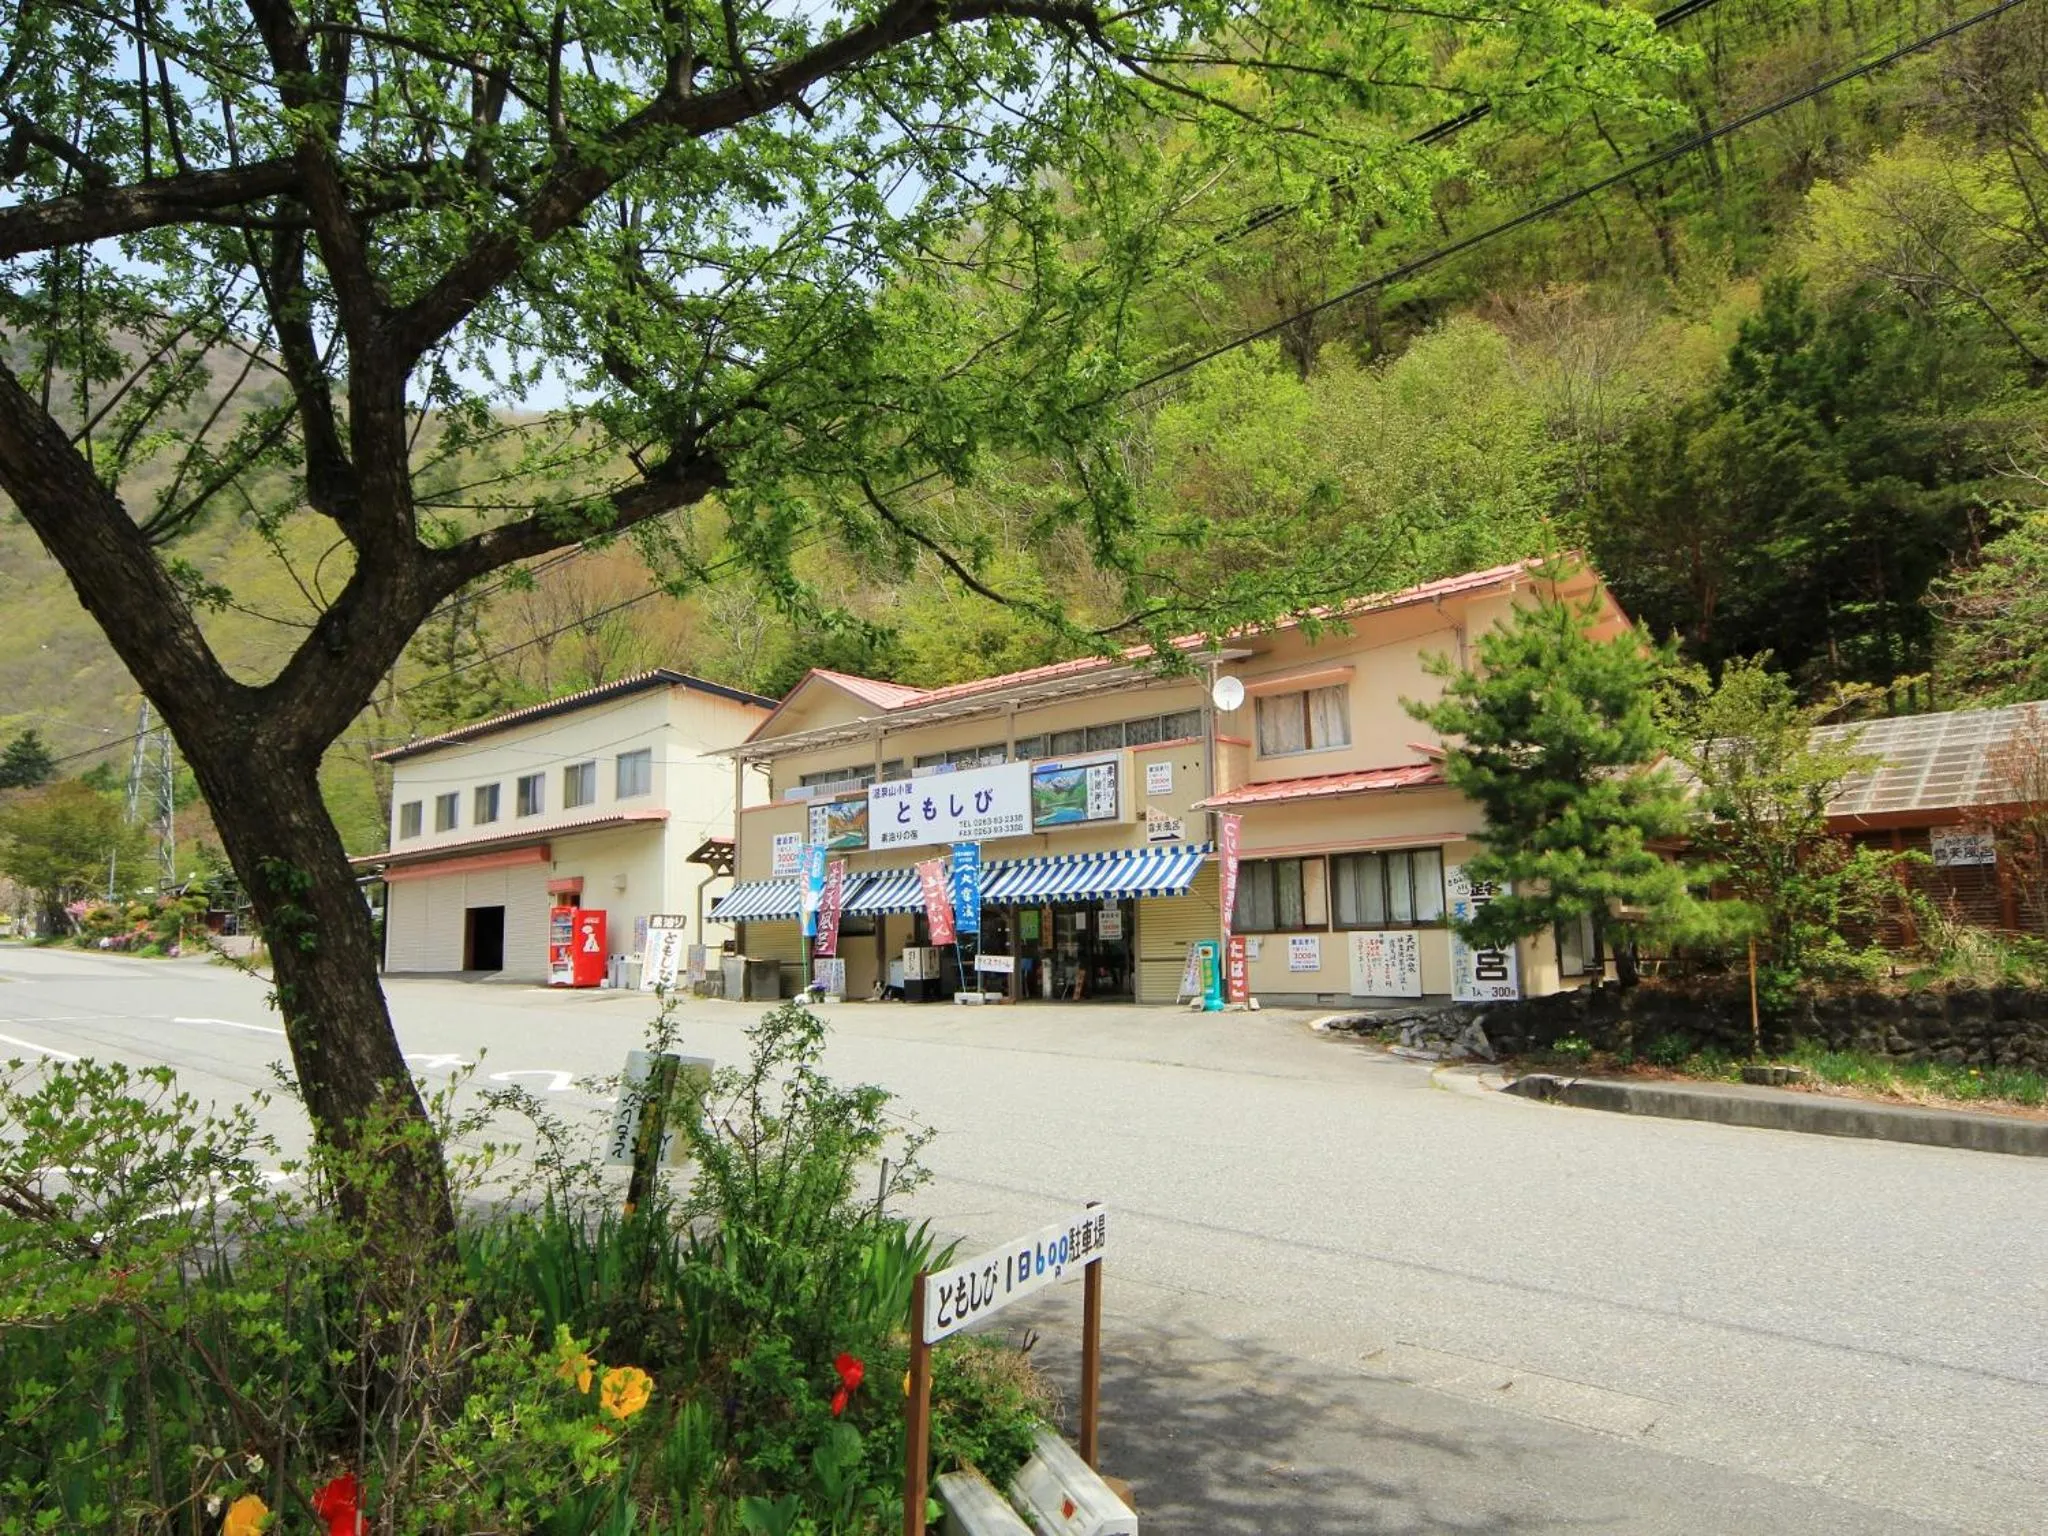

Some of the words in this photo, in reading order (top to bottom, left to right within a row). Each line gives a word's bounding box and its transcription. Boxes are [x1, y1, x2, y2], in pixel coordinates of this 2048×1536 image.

[896, 788, 994, 824] ともしび
[958, 819, 972, 828] TEL
[658, 931, 678, 983] ともしび
[937, 1260, 999, 1328] ともしび
